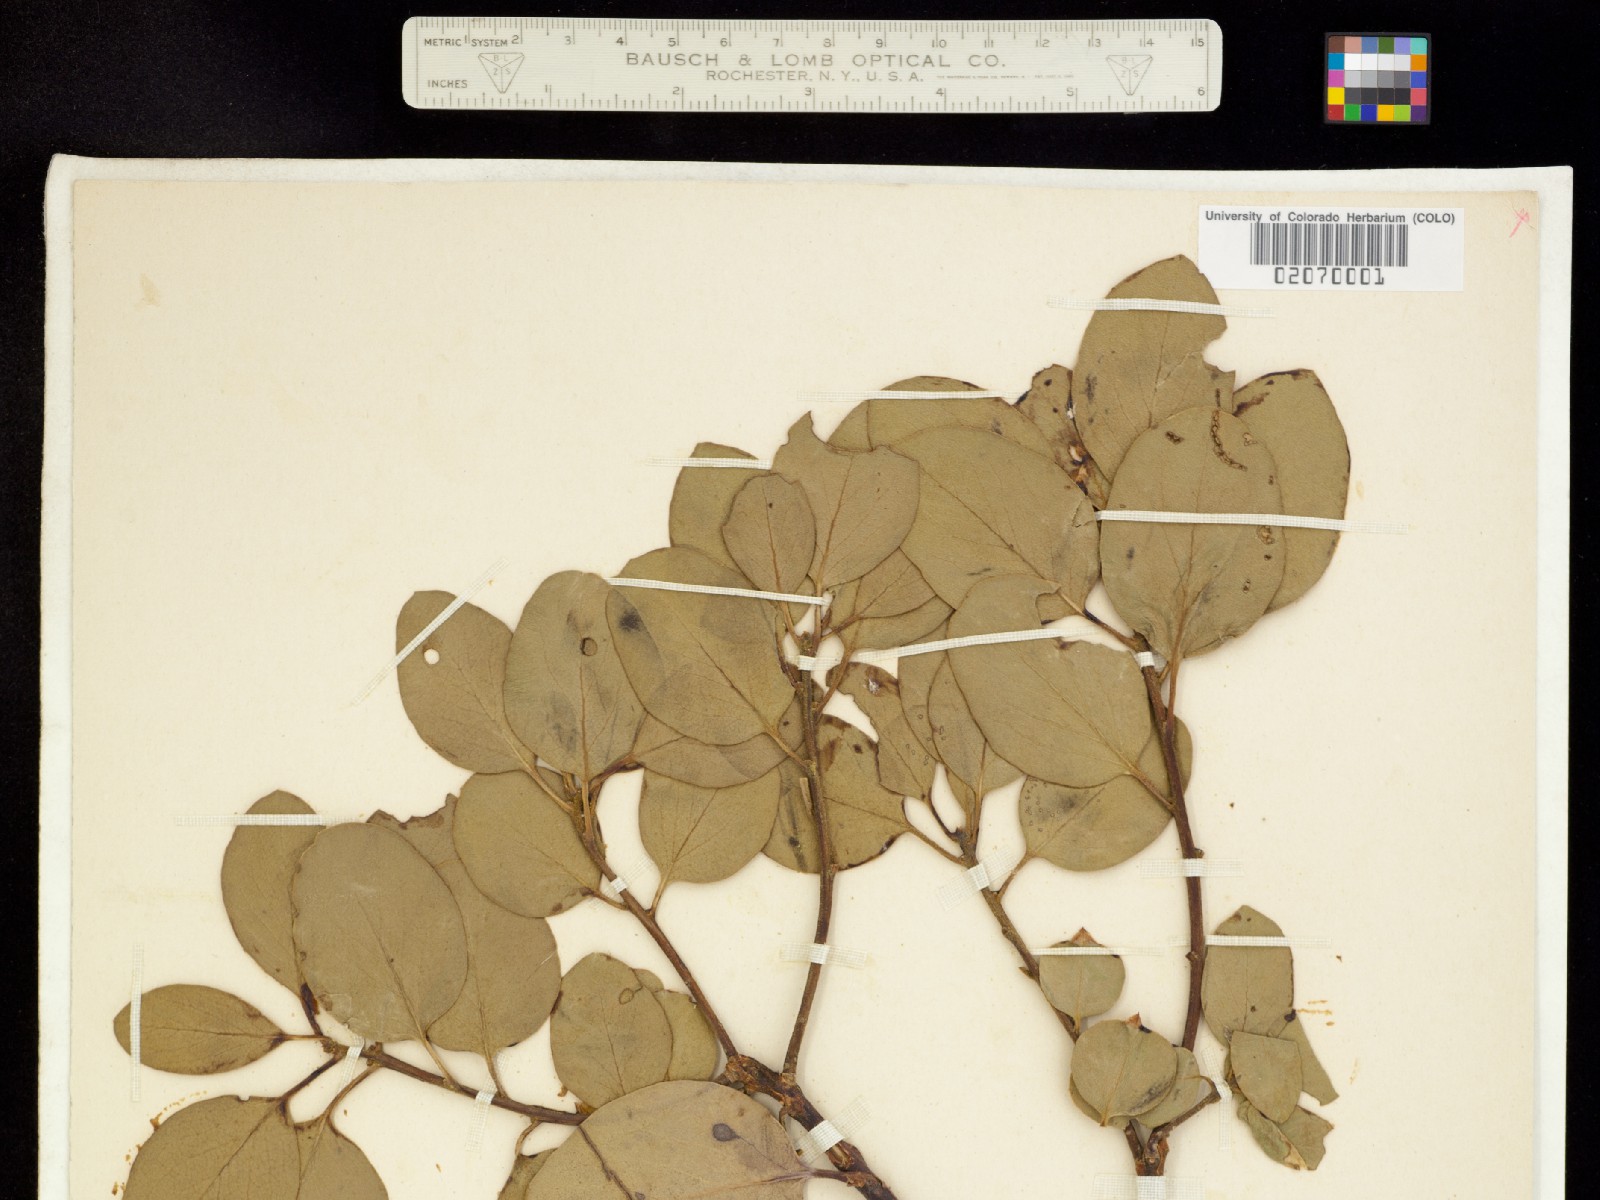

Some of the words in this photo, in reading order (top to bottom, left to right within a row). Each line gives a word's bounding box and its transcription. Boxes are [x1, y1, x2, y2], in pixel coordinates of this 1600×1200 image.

[424, 38, 462, 47] METRIC
[471, 38, 508, 47] SYSTEM
[626, 52, 719, 67] BAUSCH
[738, 53, 752, 67] &
[771, 53, 834, 67] LOMB
[852, 53, 951, 68] OPTICAL
[968, 54, 1006, 68] CO.
[427, 79, 468, 89] INCHES
[1197, 87, 1206, 97] 6
[1205, 211, 1262, 223] University
[1269, 211, 1281, 222] of
[1288, 211, 1340, 223] Colorado
[1346, 212, 1406, 223] Herbarium
[1412, 212, 1456, 225] (COLO)
[1274, 267, 1385, 286] 02070001
